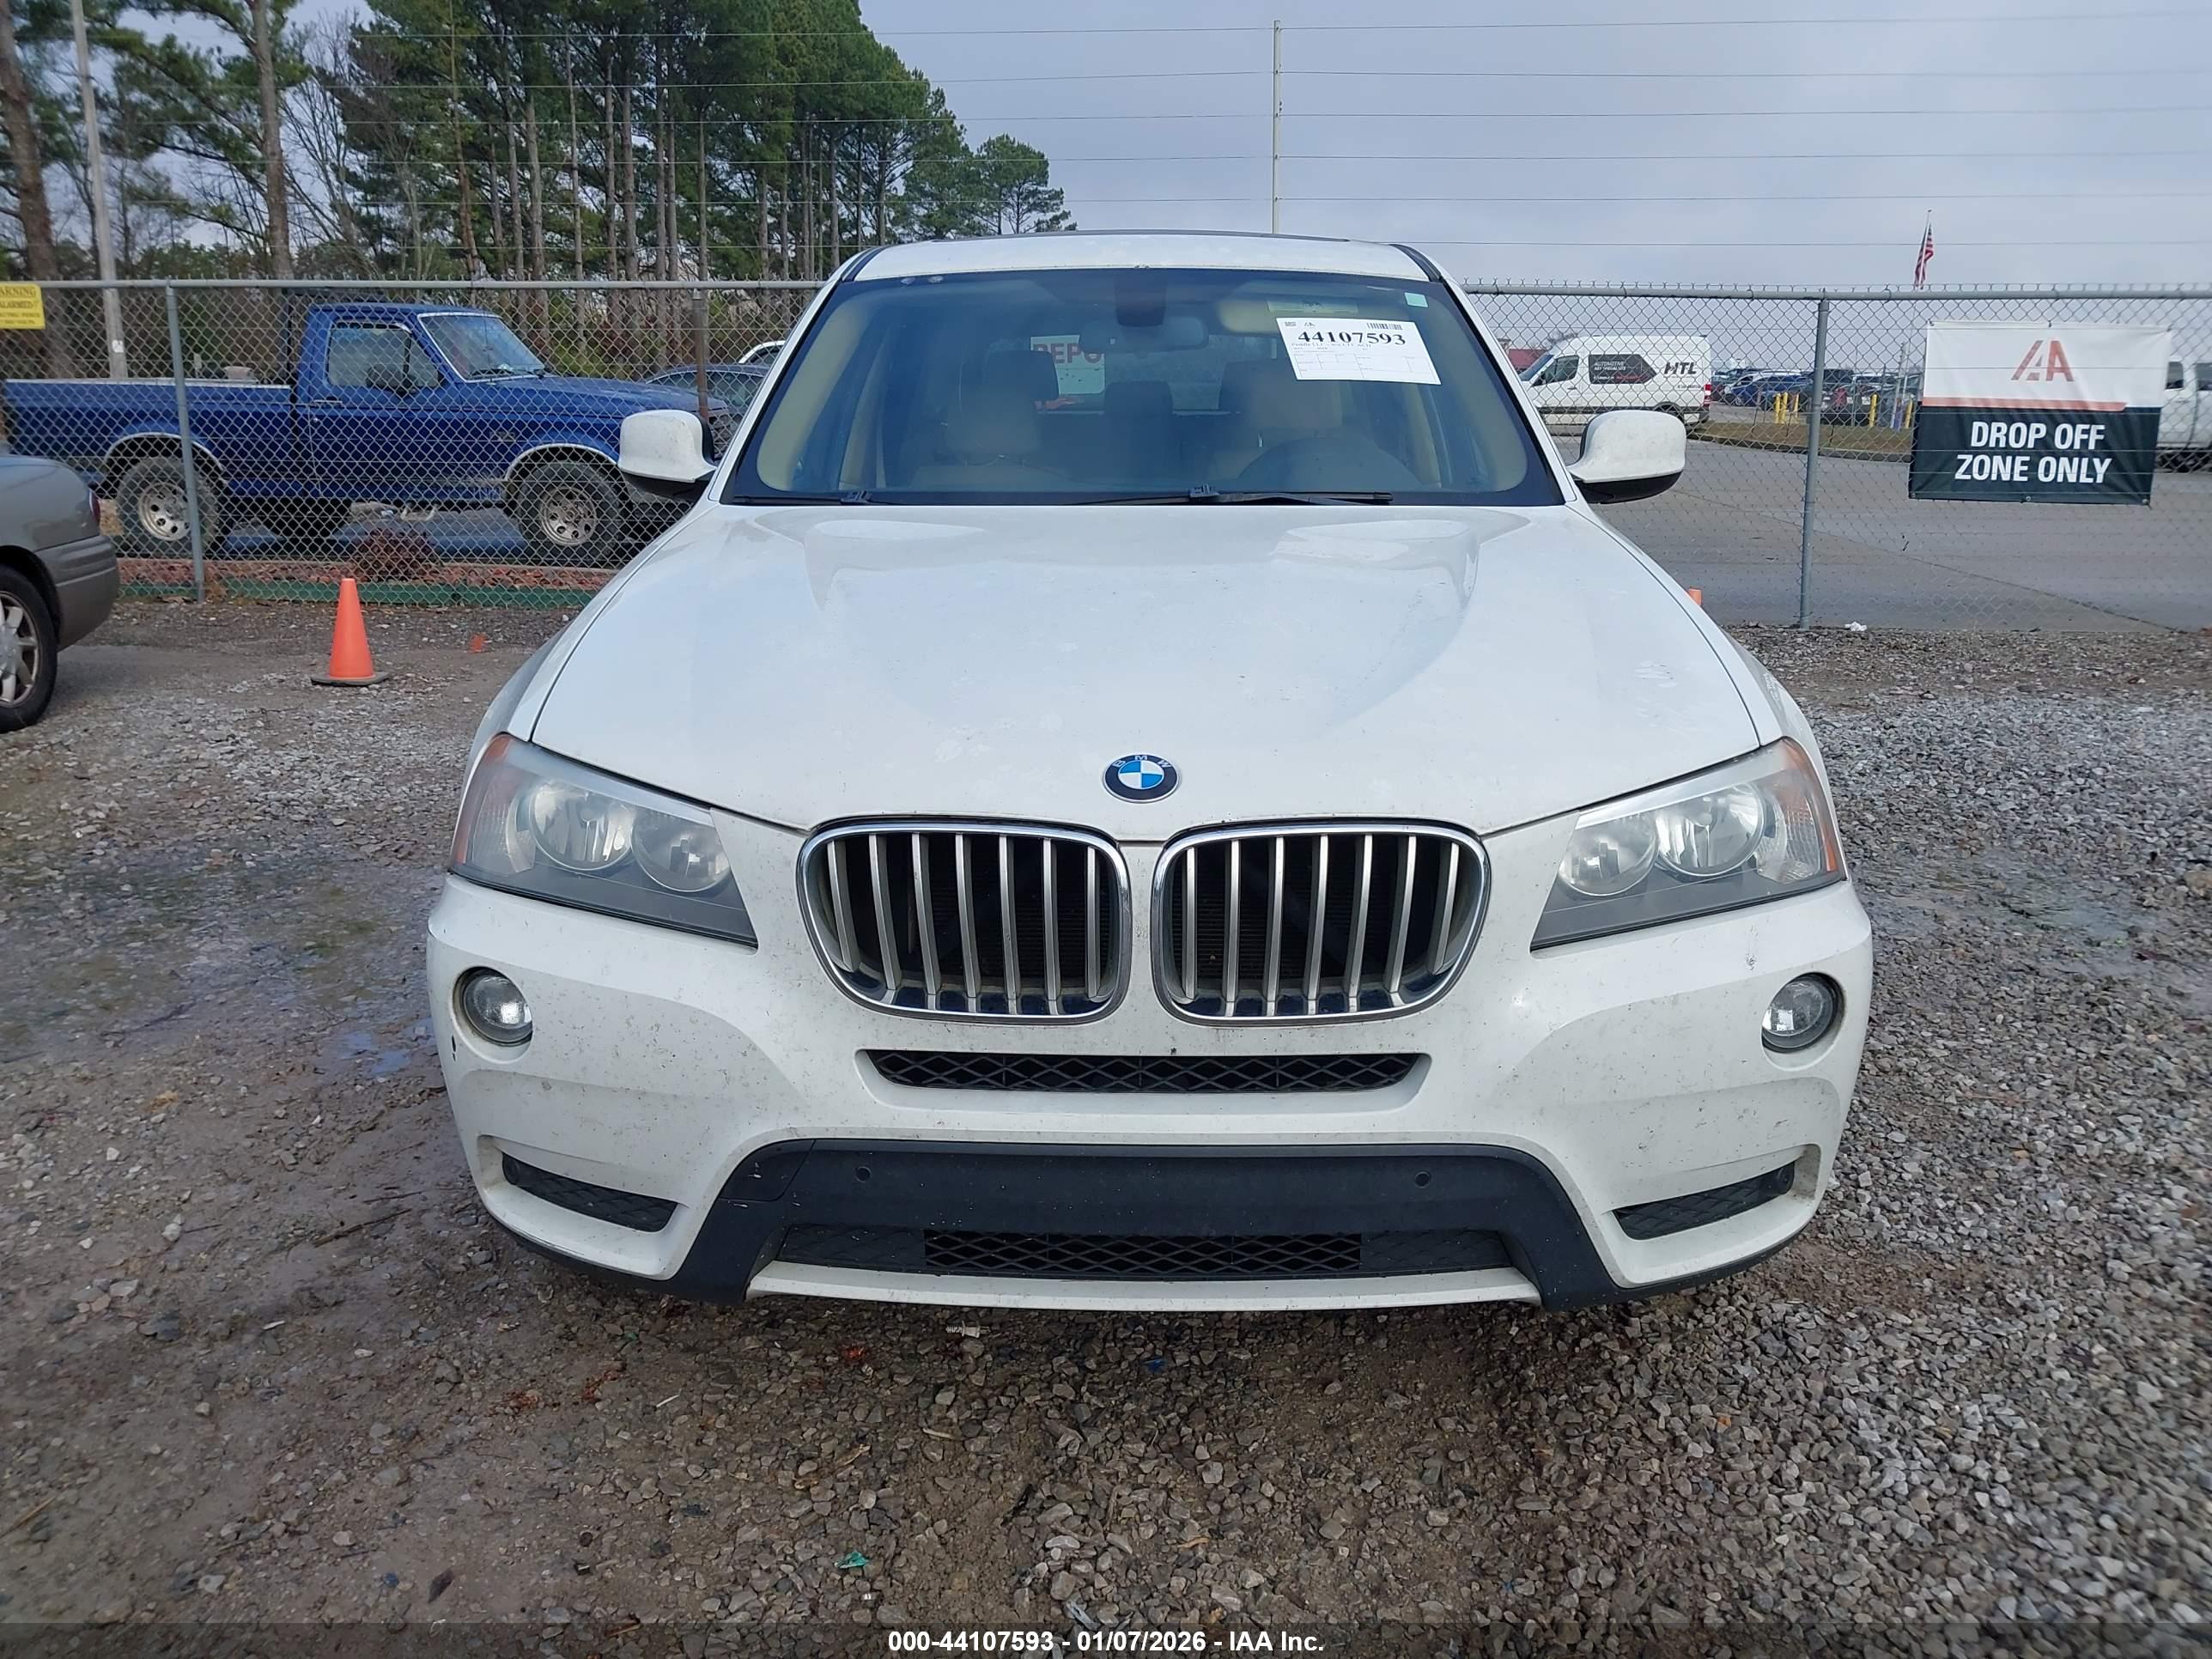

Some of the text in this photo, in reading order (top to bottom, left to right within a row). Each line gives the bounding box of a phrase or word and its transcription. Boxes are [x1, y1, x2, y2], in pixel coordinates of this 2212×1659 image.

[1298, 331, 1406, 345] 44107593
[1971, 421, 2106, 450] DROP OFF
[1954, 454, 2112, 483] ZONE ONLY
[1112, 755, 1172, 769] BMW
